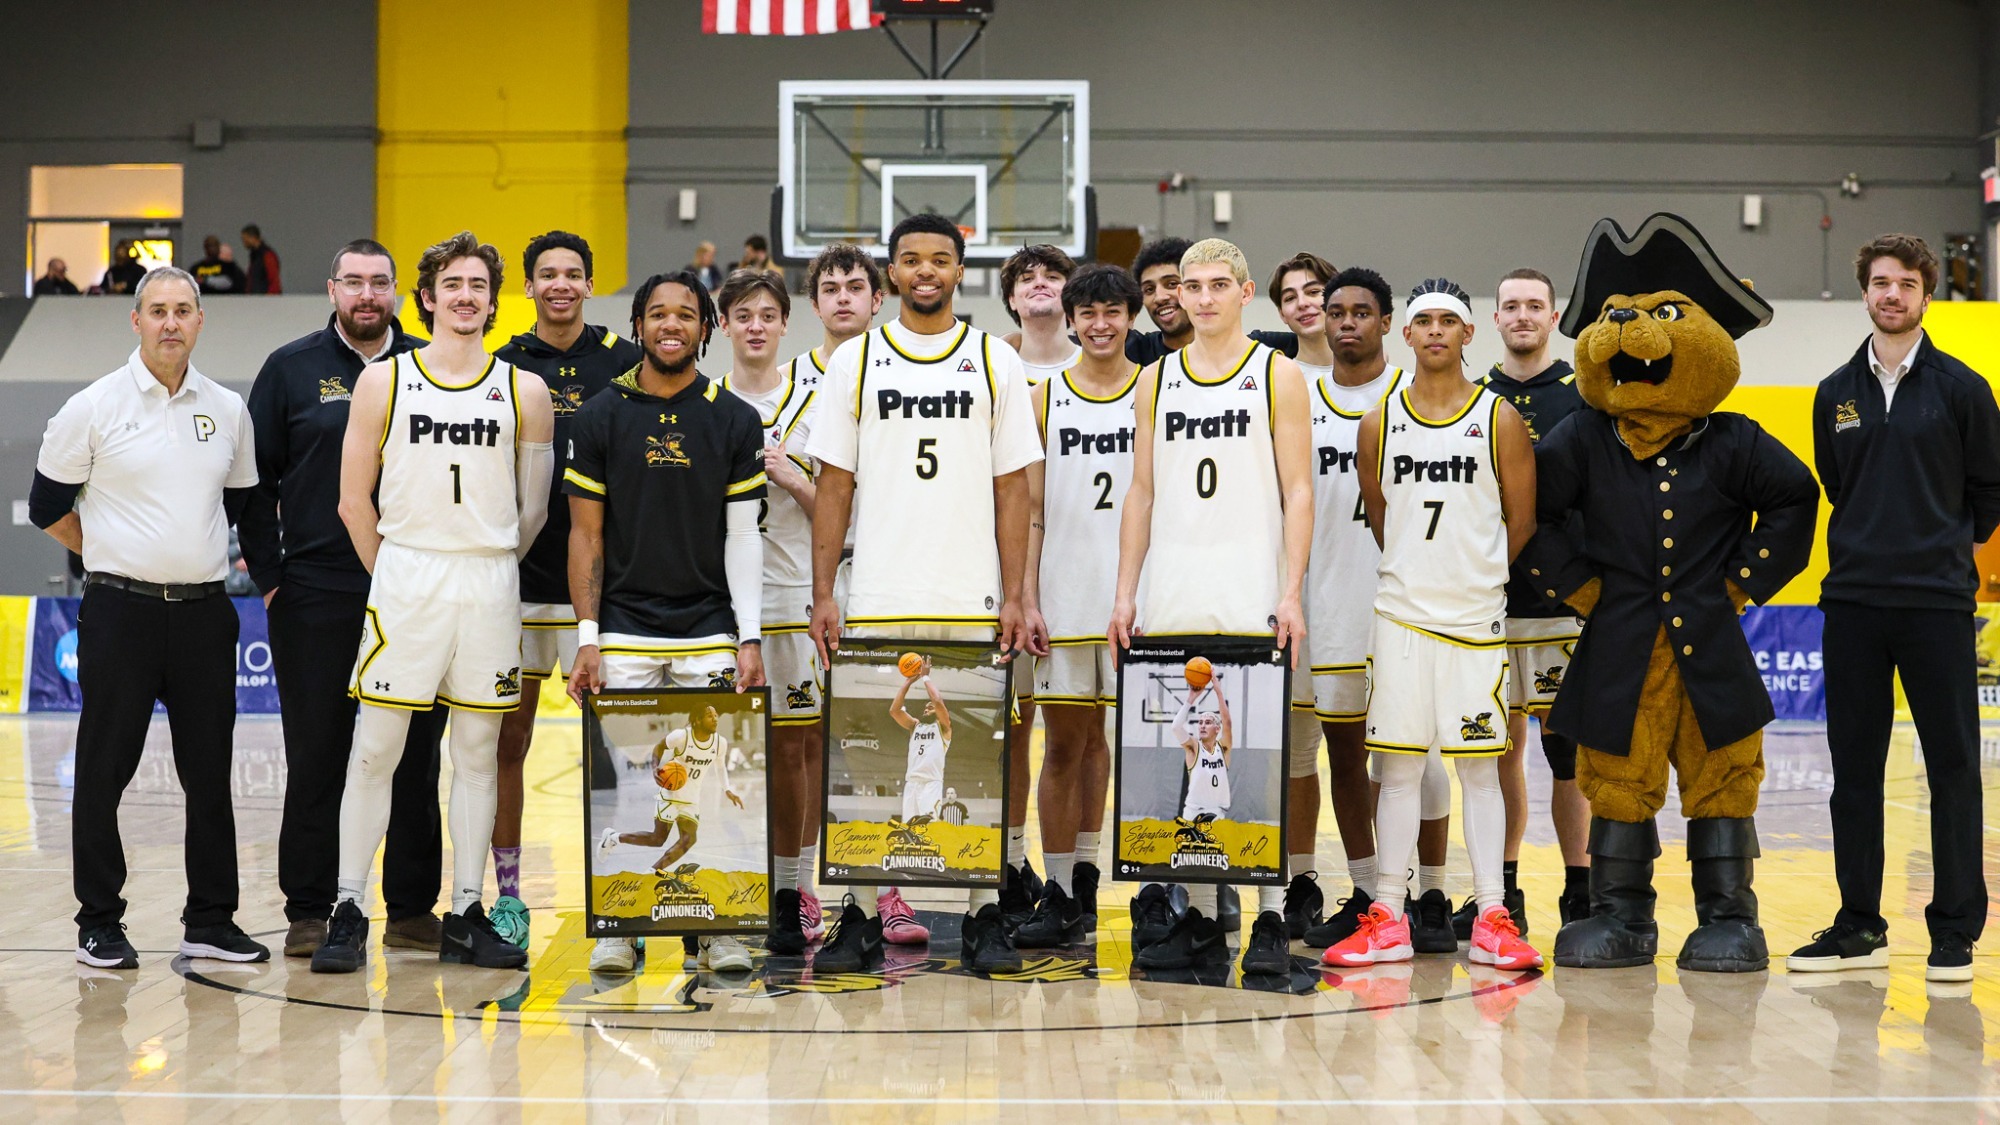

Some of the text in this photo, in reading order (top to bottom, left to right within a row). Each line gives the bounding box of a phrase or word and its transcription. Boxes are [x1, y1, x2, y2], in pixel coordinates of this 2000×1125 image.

[877, 388, 974, 420] Pratt
[193, 414, 216, 442] P
[409, 413, 501, 448] Pratt
[1165, 408, 1251, 442] Pratt
[915, 438, 938, 480] 5
[1196, 456, 1218, 499] 0
[1392, 454, 1479, 485] Pratt
[449, 463, 462, 504] 1
[1093, 471, 1114, 511] 2
[1423, 500, 1445, 541] 7
[837, 649, 853, 657] Pratt
[870, 650, 898, 658] Basketball
[1129, 648, 1144, 656] Pratt
[1271, 650, 1282, 662] P
[751, 697, 762, 709] P
[917, 744, 925, 756] 5
[688, 767, 701, 780] 10
[833, 827, 882, 846] Cameron
[1124, 824, 1174, 842] Sebastian
[834, 843, 877, 860] Hatcher
[957, 837, 990, 859] #5
[882, 854, 946, 873] CANNONEERS
[1170, 852, 1230, 872] CANNONEERS
[601, 878, 642, 898] Mekhi
[725, 881, 767, 906] #10
[602, 892, 637, 911] Davis
[651, 903, 716, 922] CANNONEERS
